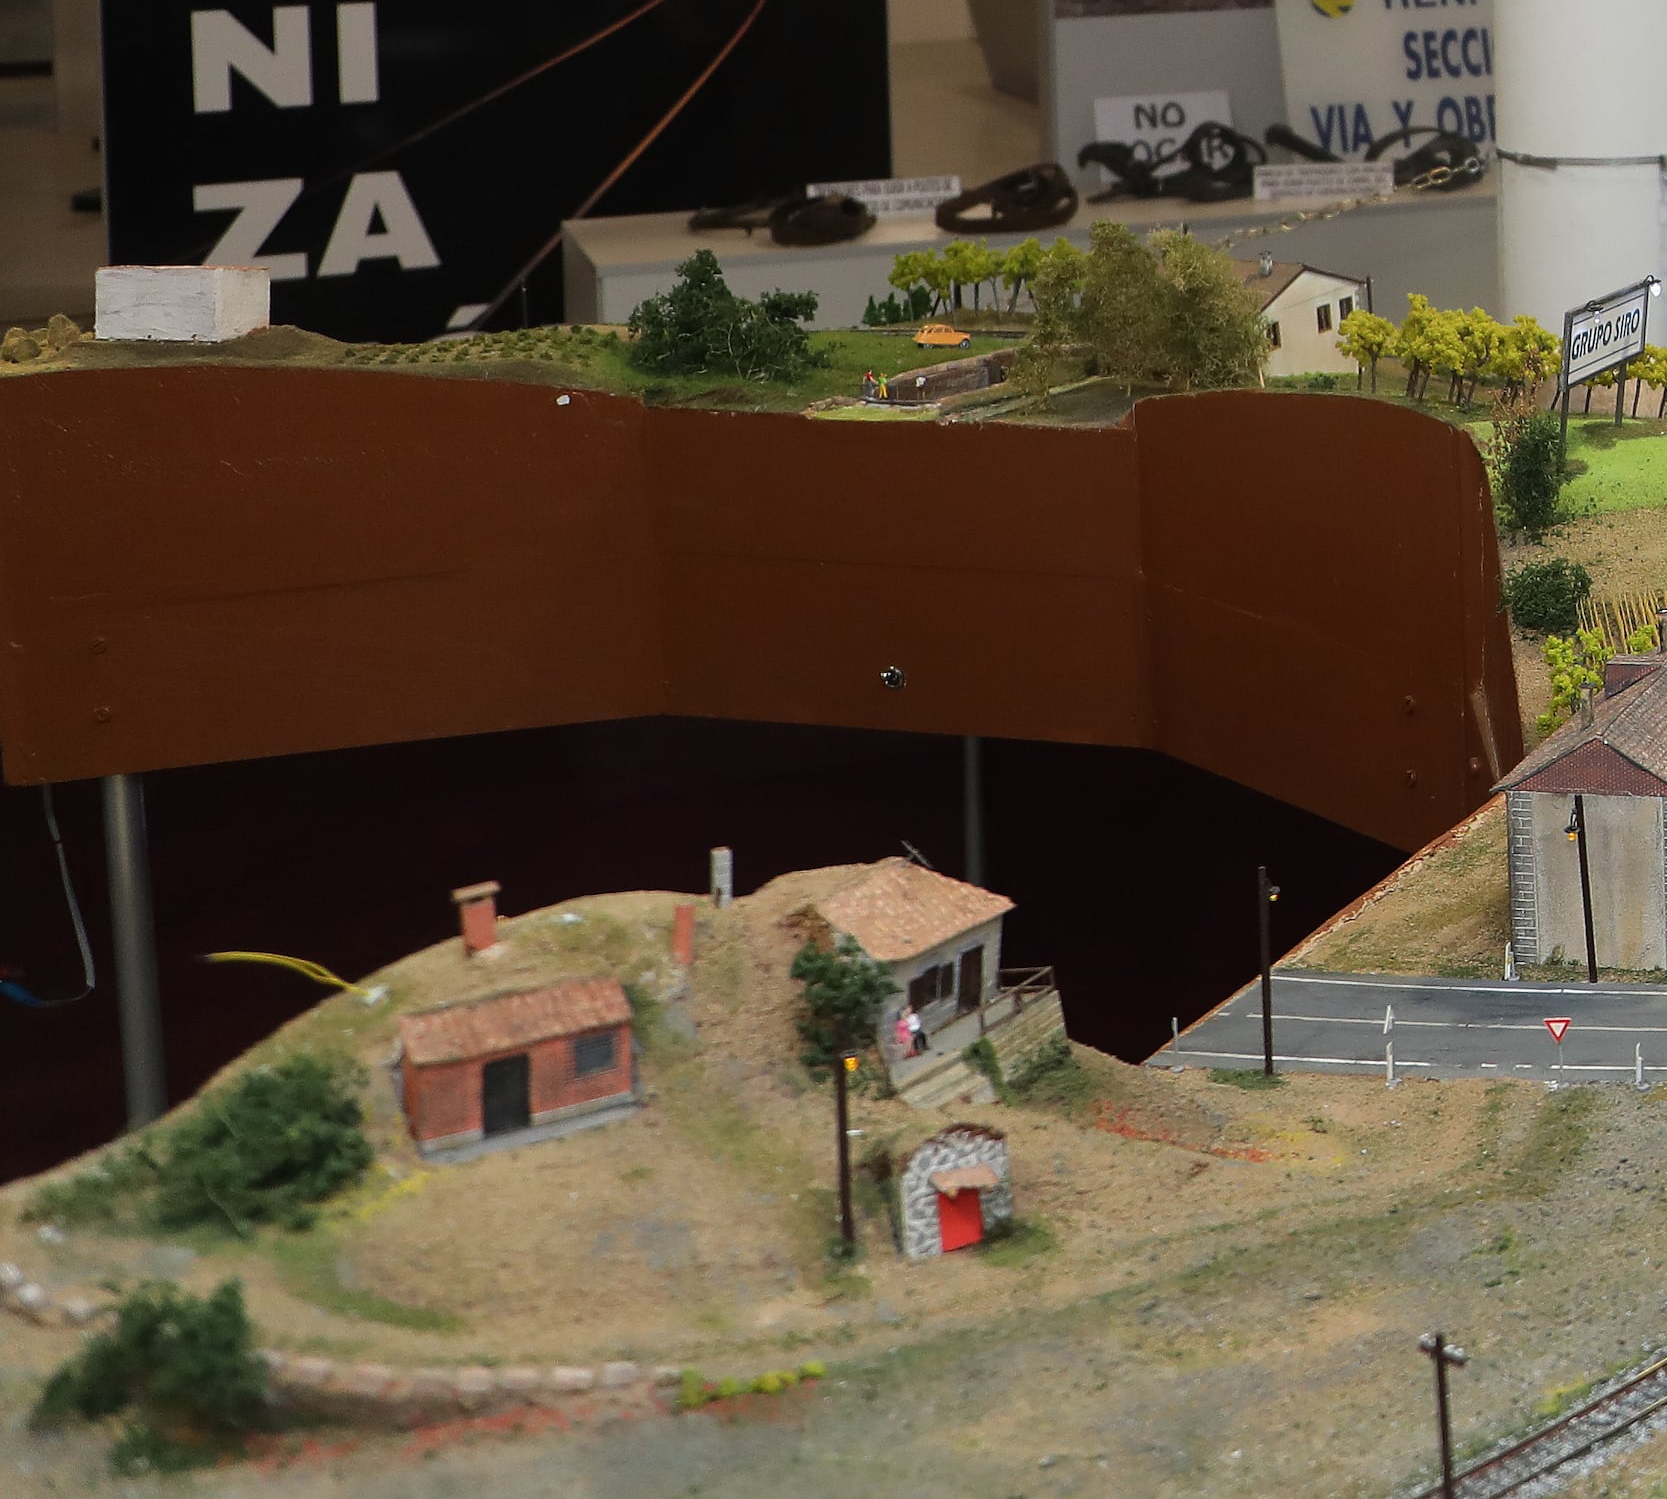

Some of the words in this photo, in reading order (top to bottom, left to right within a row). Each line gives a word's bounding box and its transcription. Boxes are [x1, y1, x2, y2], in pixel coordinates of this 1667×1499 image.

[190, 1, 379, 114] NI
[1404, 26, 1494, 81] SECCI
[1133, 102, 1186, 129] NO
[1310, 101, 1373, 152] VIA
[1392, 100, 1414, 149] Y
[1437, 93, 1497, 144] OB
[192, 170, 441, 281] ZA
[1572, 321, 1612, 360] GRUPO
[1614, 308, 1640, 342] SIRO
